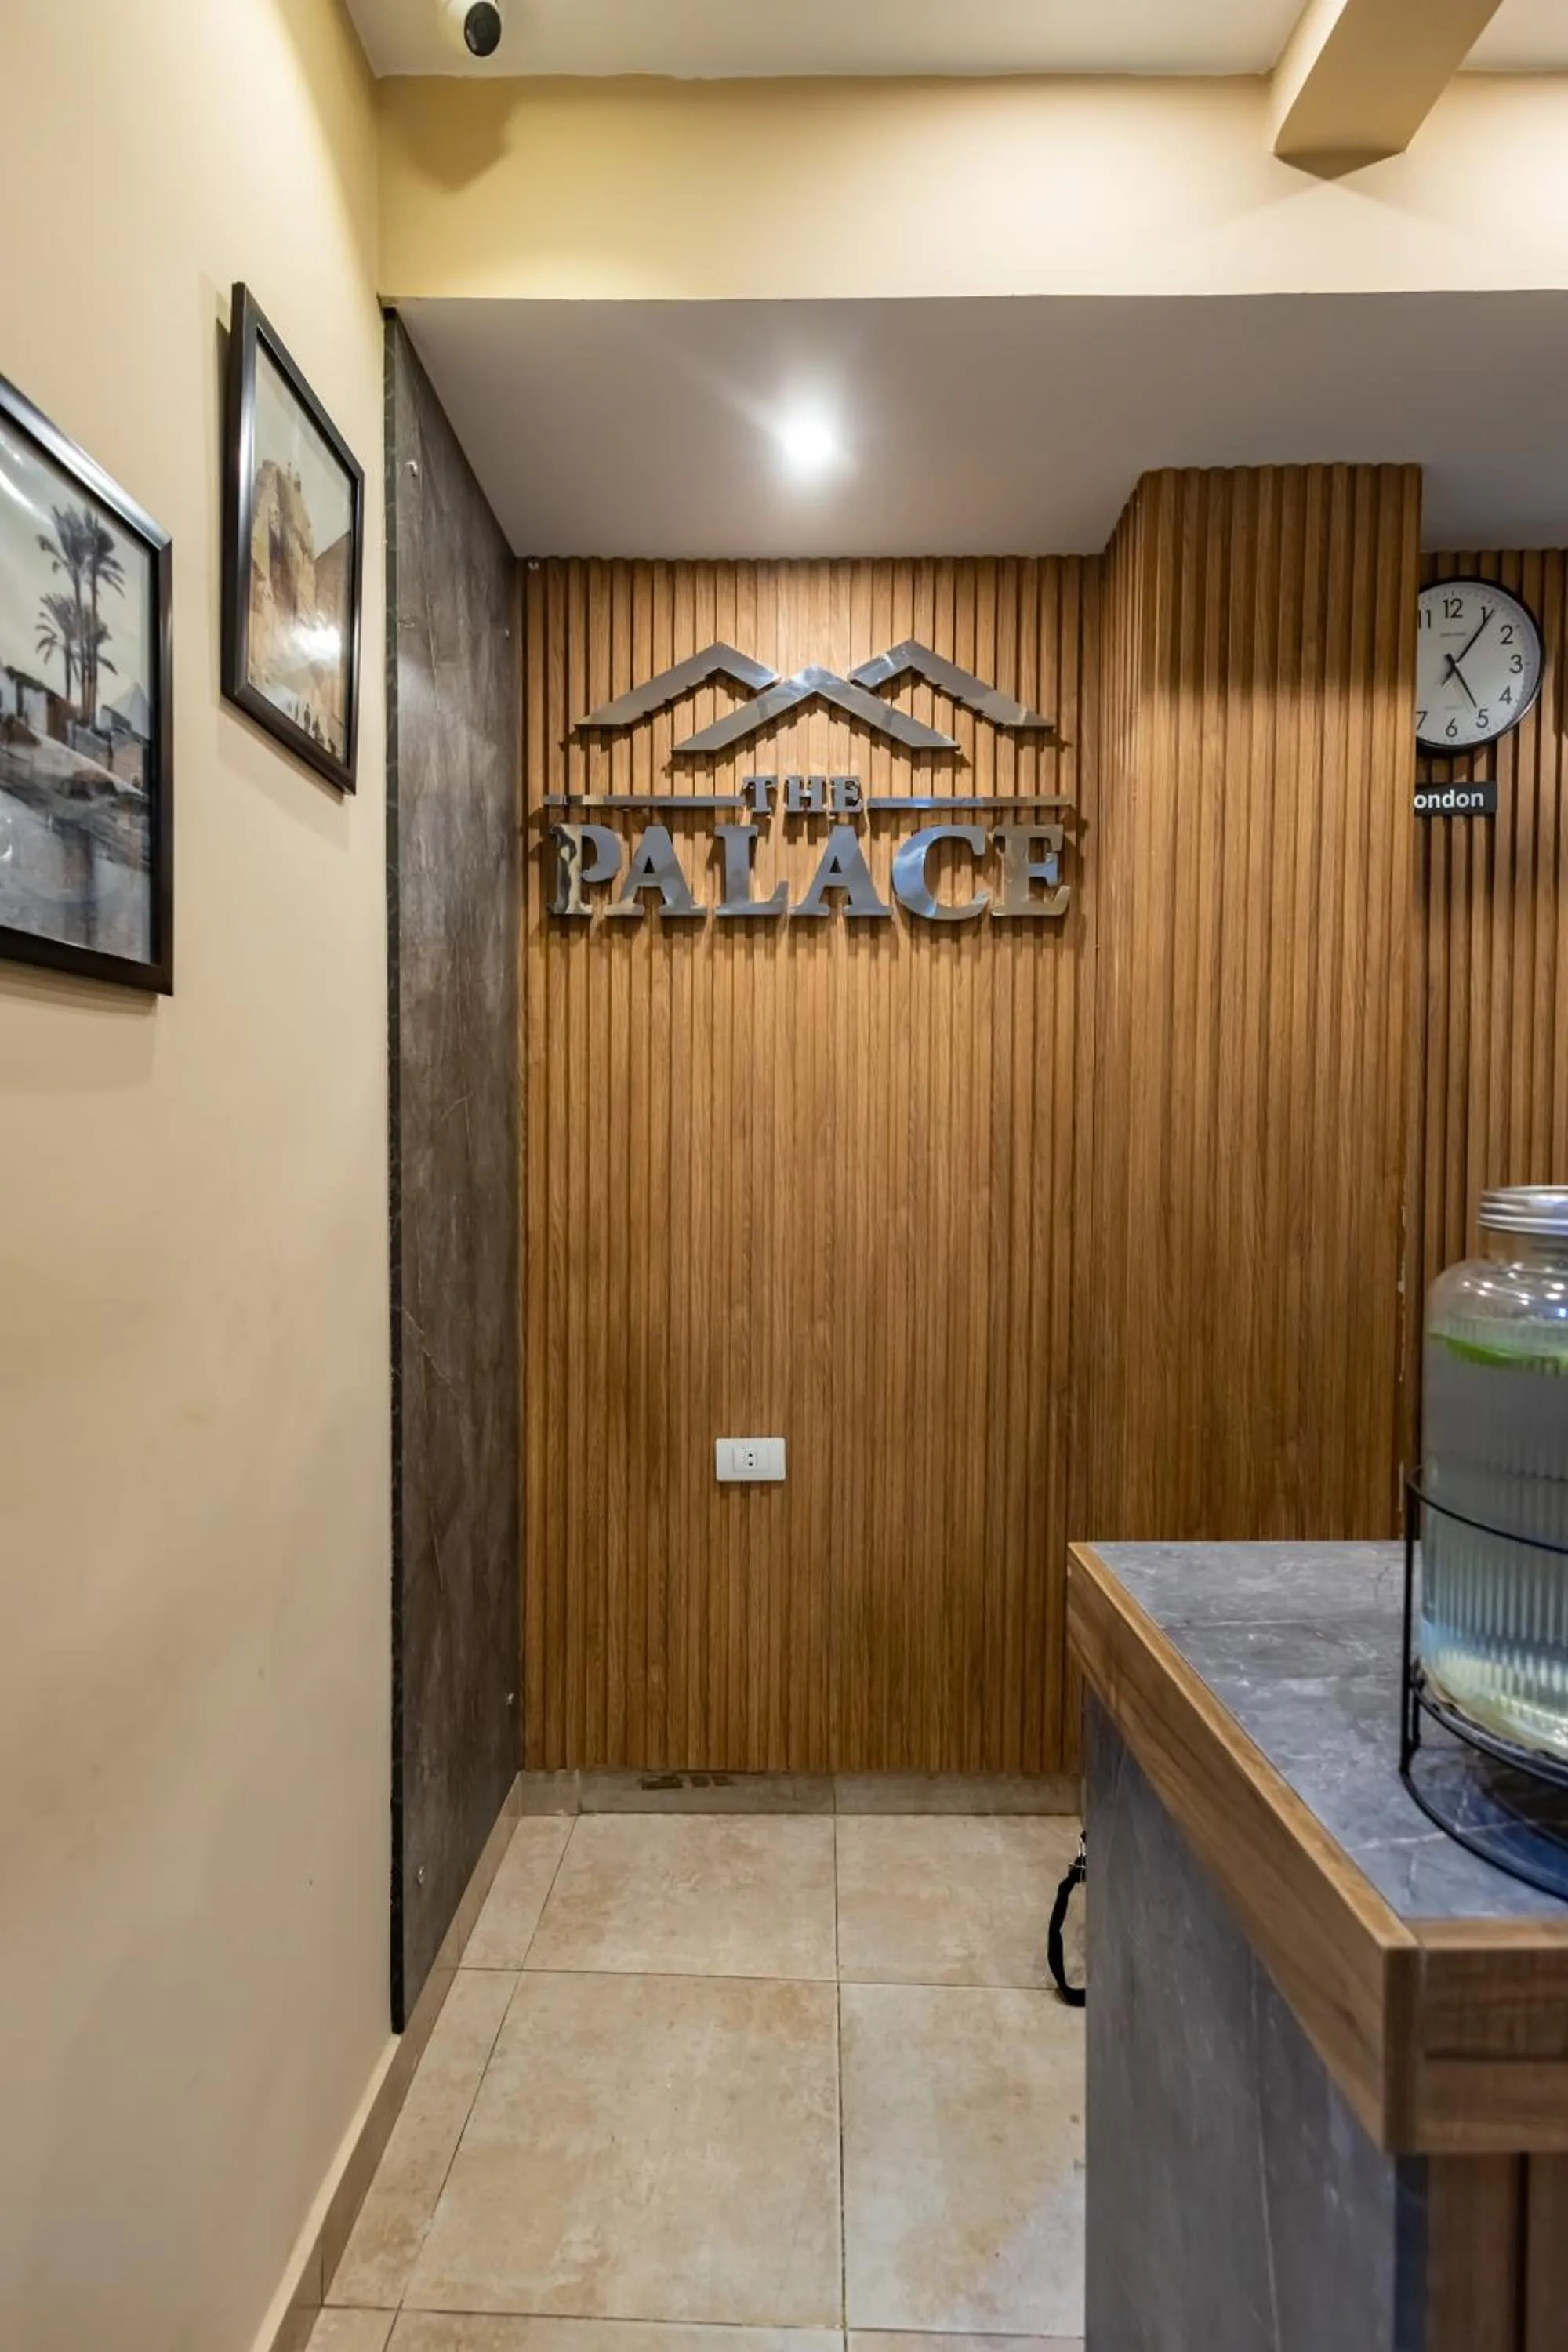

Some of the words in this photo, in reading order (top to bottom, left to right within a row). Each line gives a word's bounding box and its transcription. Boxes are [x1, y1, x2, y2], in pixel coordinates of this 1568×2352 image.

[1443, 598, 1463, 618] 12
[1500, 625, 1514, 644] 2
[1510, 655, 1523, 673] 3
[1499, 686, 1512, 704] 4
[1417, 711, 1428, 730] 7
[1445, 718, 1458, 738] 6
[1475, 709, 1489, 728] 5
[742, 775, 862, 813] THE
[1414, 789, 1484, 809] ondon
[548, 824, 1071, 920] PALACE
